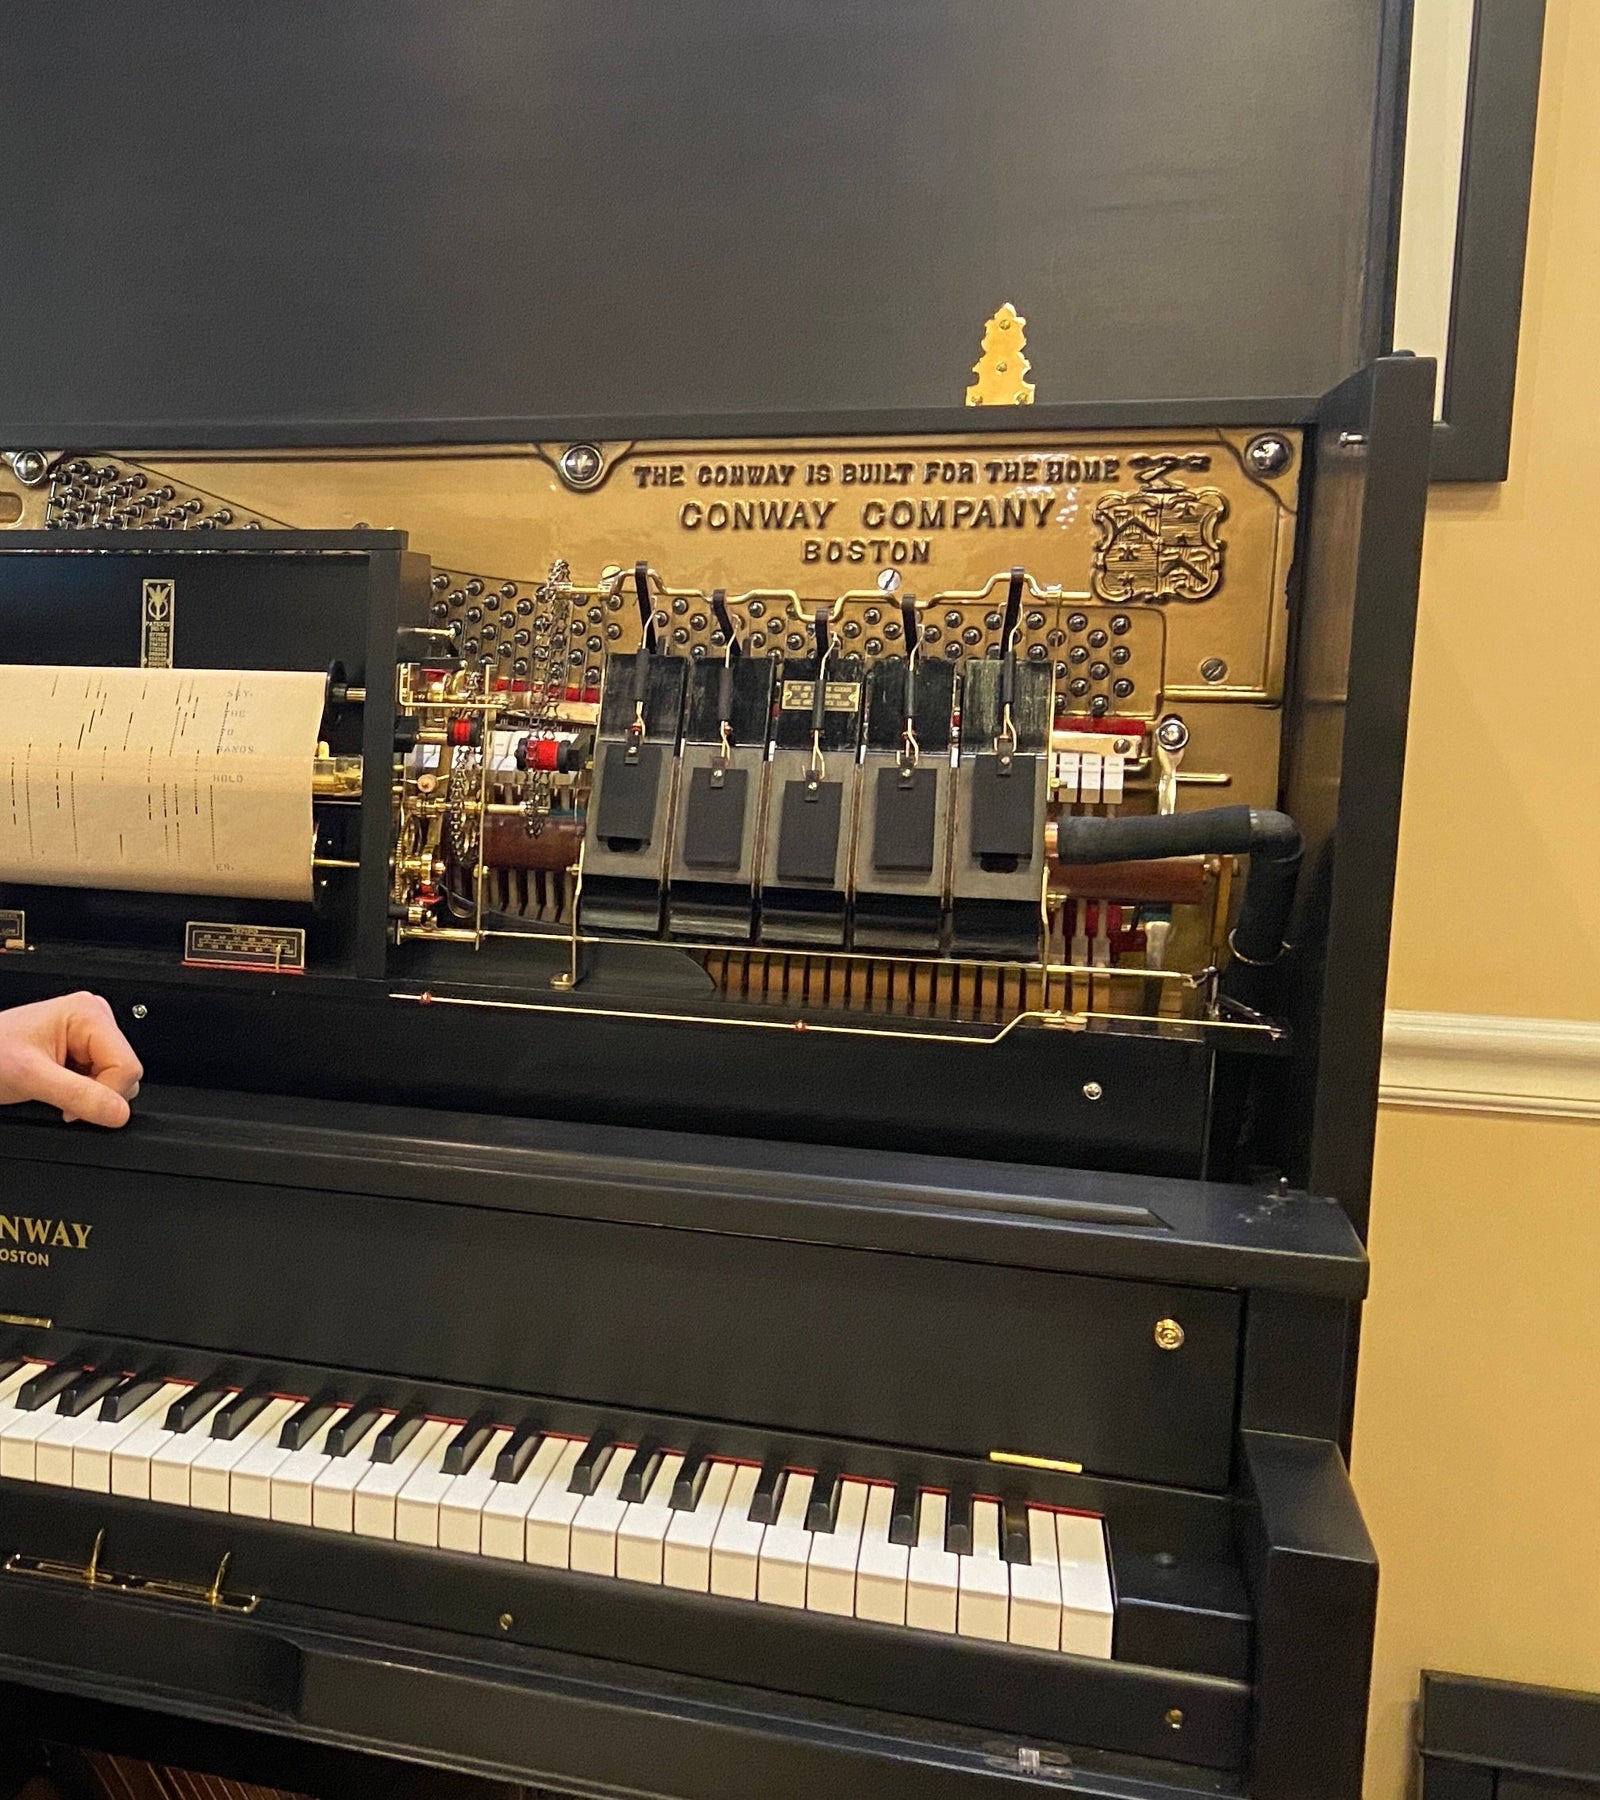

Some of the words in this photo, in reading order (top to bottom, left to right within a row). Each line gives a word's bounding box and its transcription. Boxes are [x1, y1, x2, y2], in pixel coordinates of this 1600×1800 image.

[633, 464, 684, 487] THE
[697, 464, 796, 487] CONWAY
[805, 464, 828, 486] IS
[840, 462, 914, 485] BUILT
[924, 460, 979, 485] FOR
[983, 459, 1041, 484] THE
[1045, 458, 1120, 484] HOME
[679, 499, 838, 531] CONWAY
[861, 497, 1057, 530] COMPANY
[802, 537, 933, 565] BOSTON
